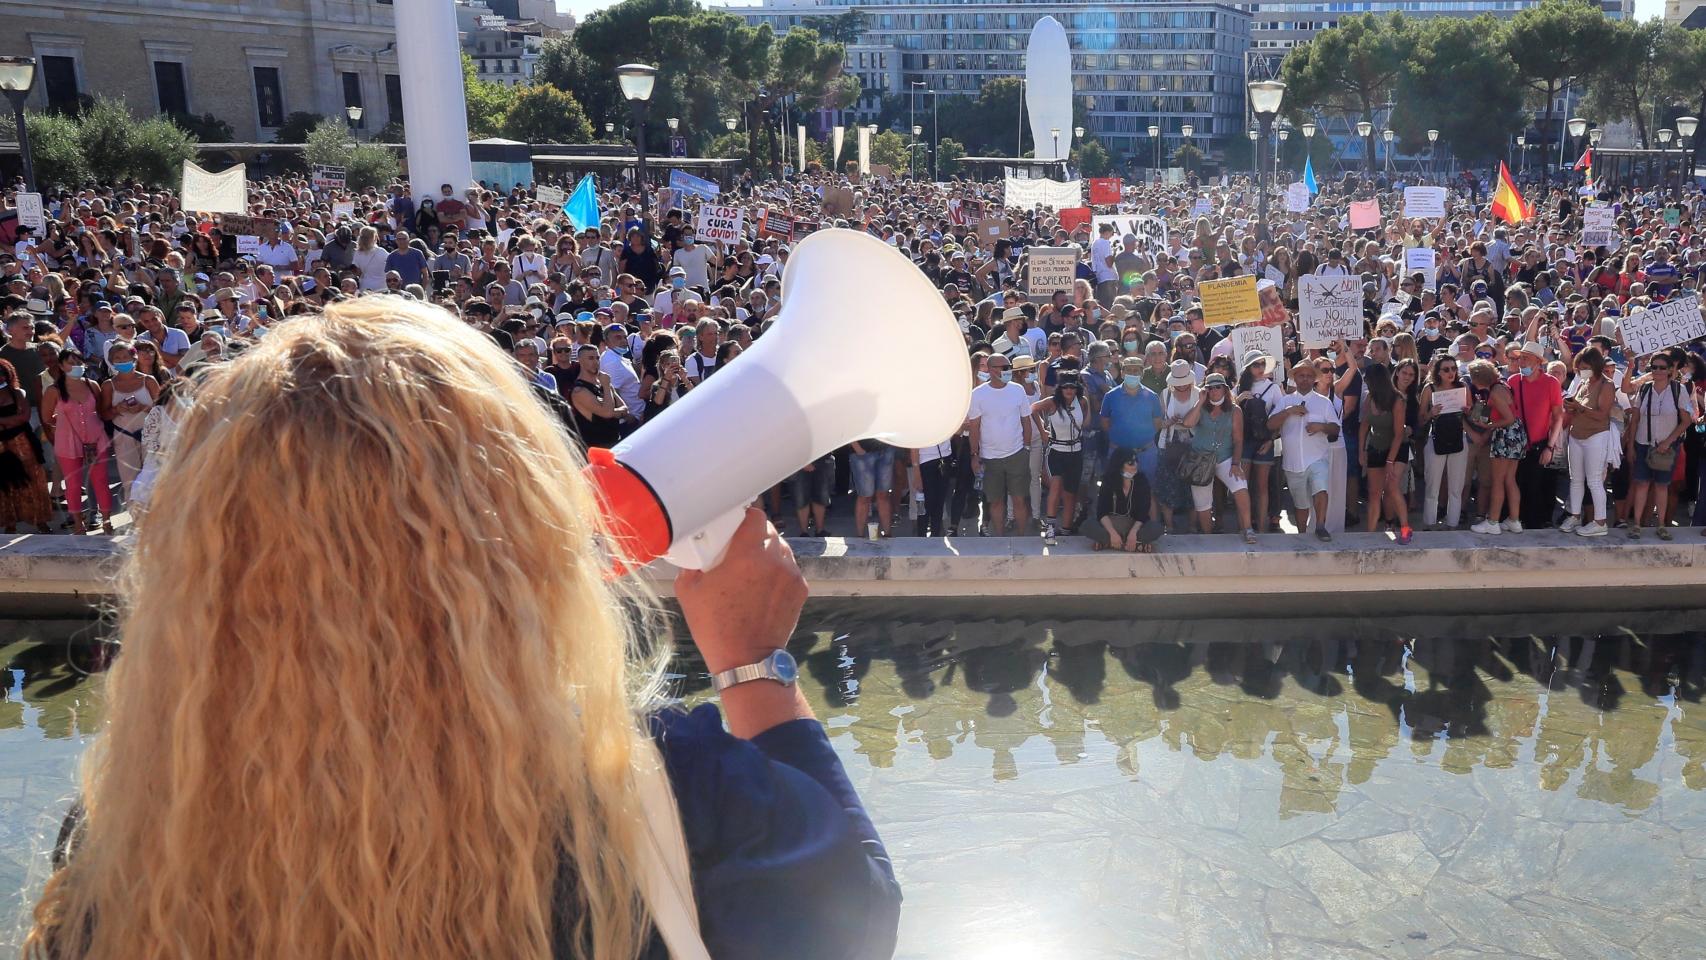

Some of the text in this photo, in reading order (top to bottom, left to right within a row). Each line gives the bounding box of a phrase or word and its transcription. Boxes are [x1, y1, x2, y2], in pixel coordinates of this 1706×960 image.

[704, 207, 738, 219] EL CDS
[707, 218, 734, 229] CURA
[705, 228, 738, 240] COVID19
[1032, 276, 1072, 285] DESPIERTA
[1622, 317, 1637, 331] EL
[1626, 312, 1700, 341] INEVITABLE
[1630, 322, 1706, 355] LIBERTAD
